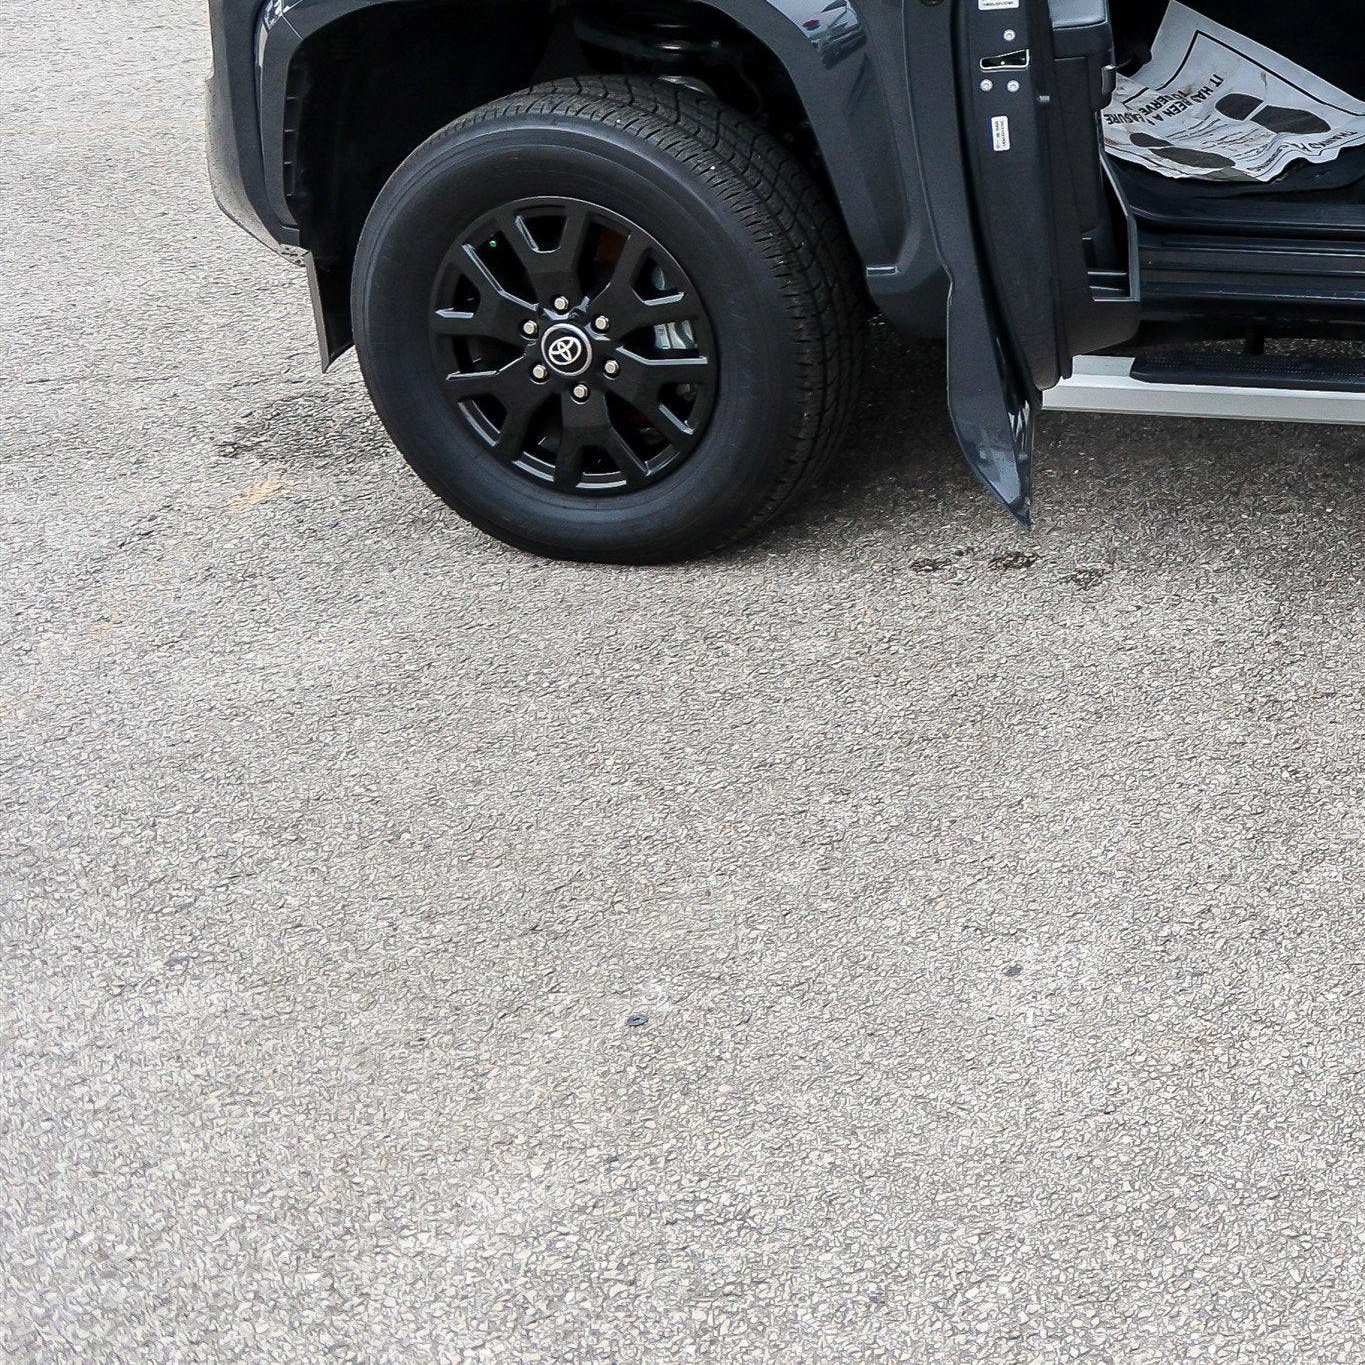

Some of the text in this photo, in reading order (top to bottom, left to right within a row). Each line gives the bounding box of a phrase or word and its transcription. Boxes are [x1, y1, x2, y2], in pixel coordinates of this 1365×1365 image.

[1209, 74, 1224, 87] IT
[1190, 86, 1214, 103] HAS
[1162, 97, 1194, 117] BEEN
[1152, 110, 1164, 122] A
